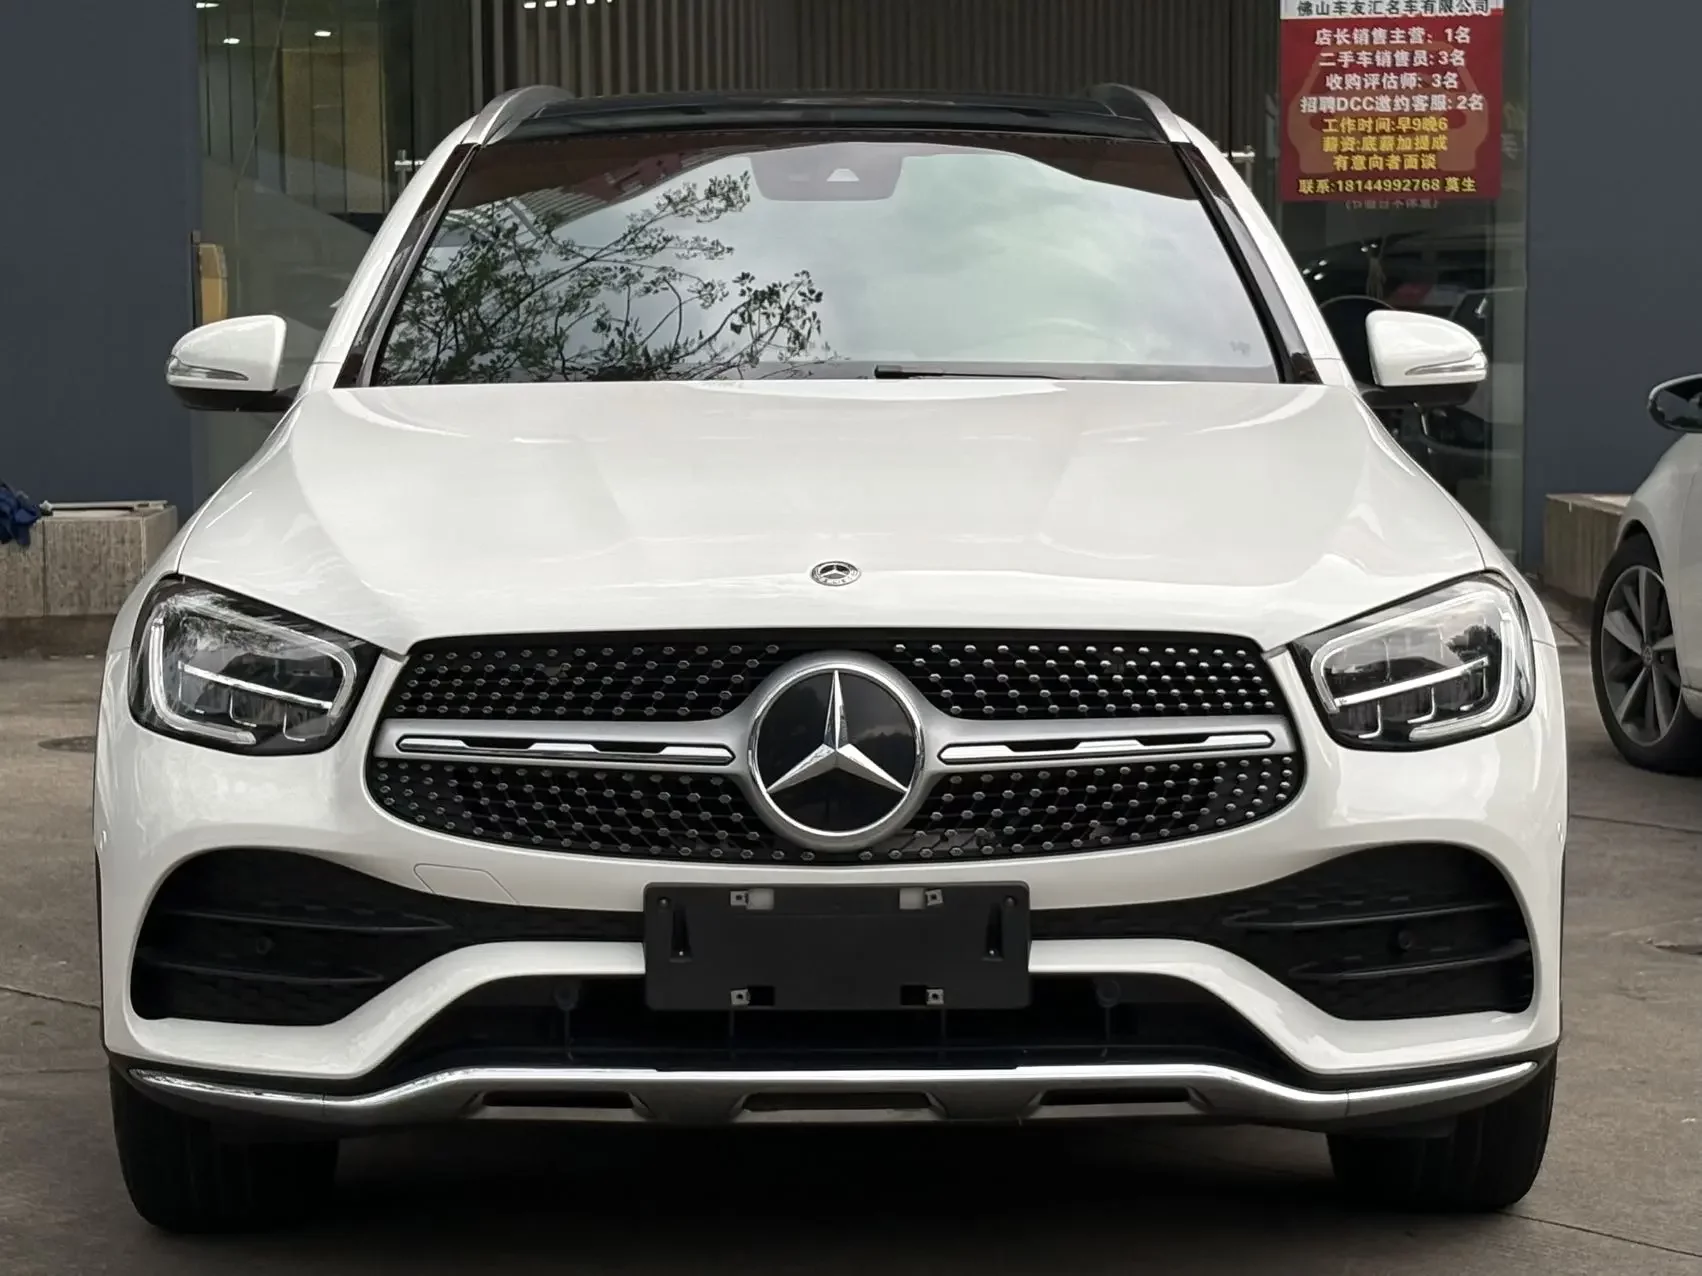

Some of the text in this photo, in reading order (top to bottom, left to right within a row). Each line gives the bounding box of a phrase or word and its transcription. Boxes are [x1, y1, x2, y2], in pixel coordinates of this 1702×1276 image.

[1333, 153, 1437, 171] 有意向者面谈
